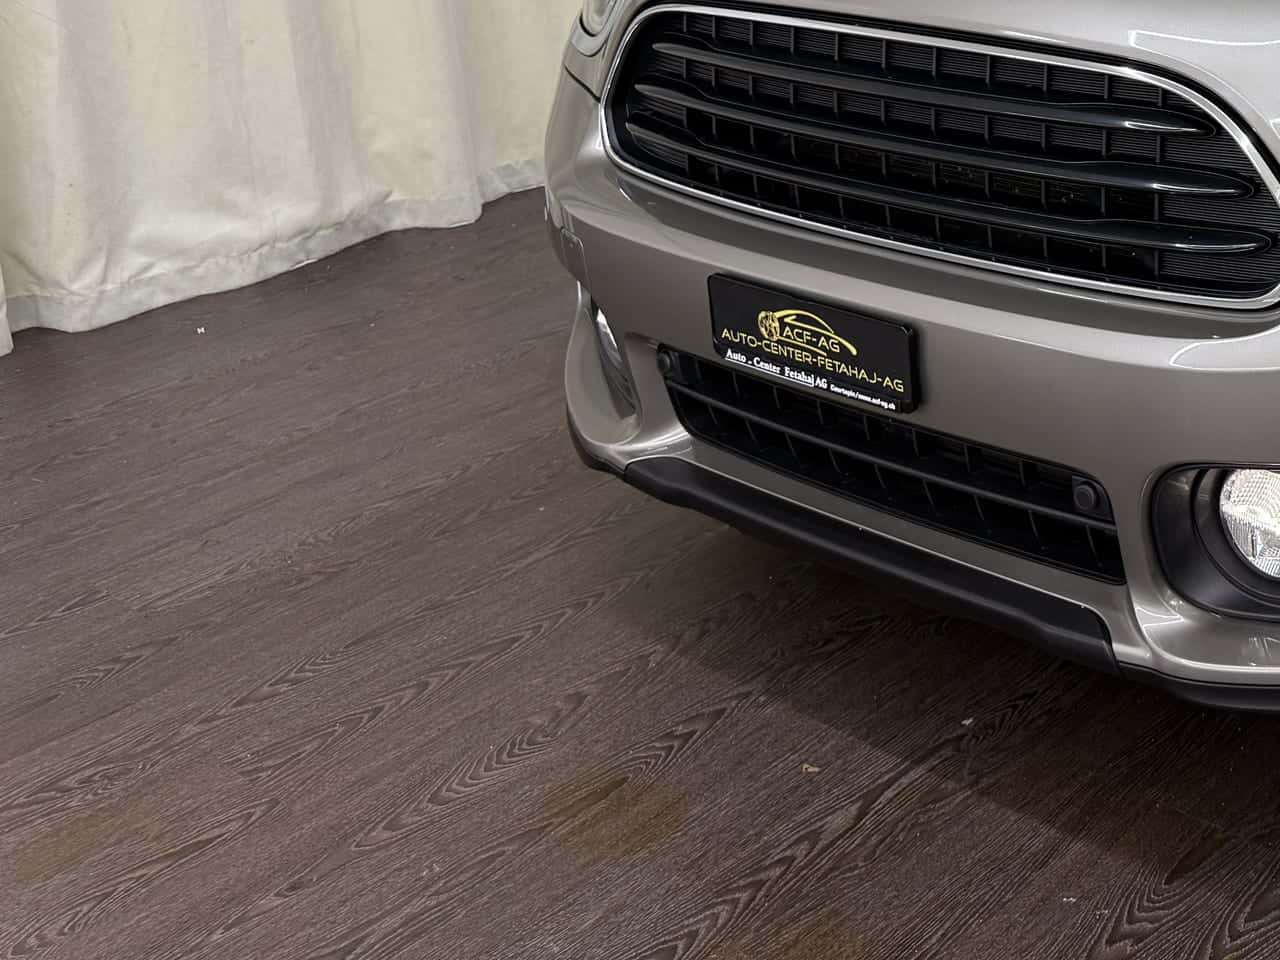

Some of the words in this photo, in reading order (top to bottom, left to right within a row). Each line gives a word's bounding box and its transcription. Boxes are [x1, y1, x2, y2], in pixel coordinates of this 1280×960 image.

[721, 328, 905, 393] AUTO-CENTER-FETAHAJ-AG
[782, 326, 841, 353] ACF-AG
[726, 347, 746, 362] Auto
[753, 357, 781, 374] Center
[784, 366, 815, 386] Fetahaj
[815, 376, 828, 389] AG
